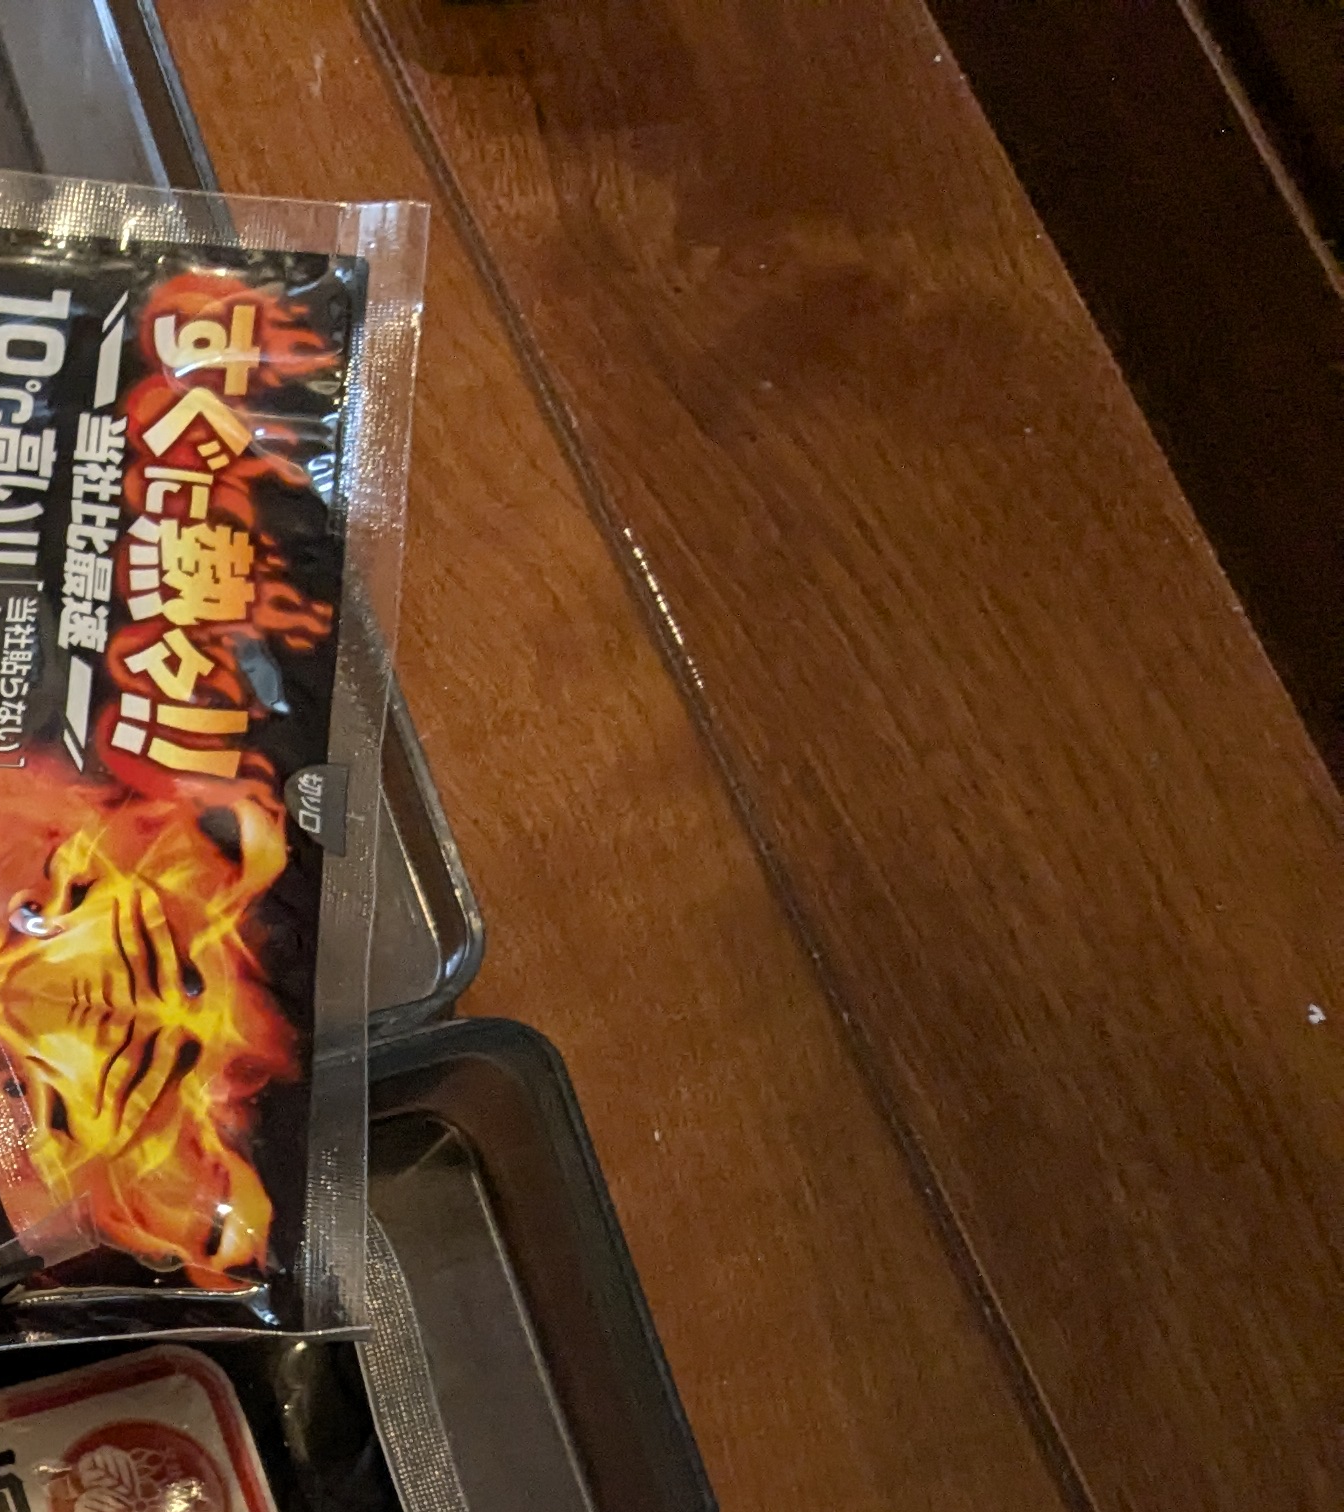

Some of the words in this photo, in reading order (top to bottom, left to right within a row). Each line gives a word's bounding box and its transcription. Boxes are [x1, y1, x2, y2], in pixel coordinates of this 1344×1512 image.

[57, 412, 130, 657] 当社比最速
[296, 772, 326, 833] 切り口
